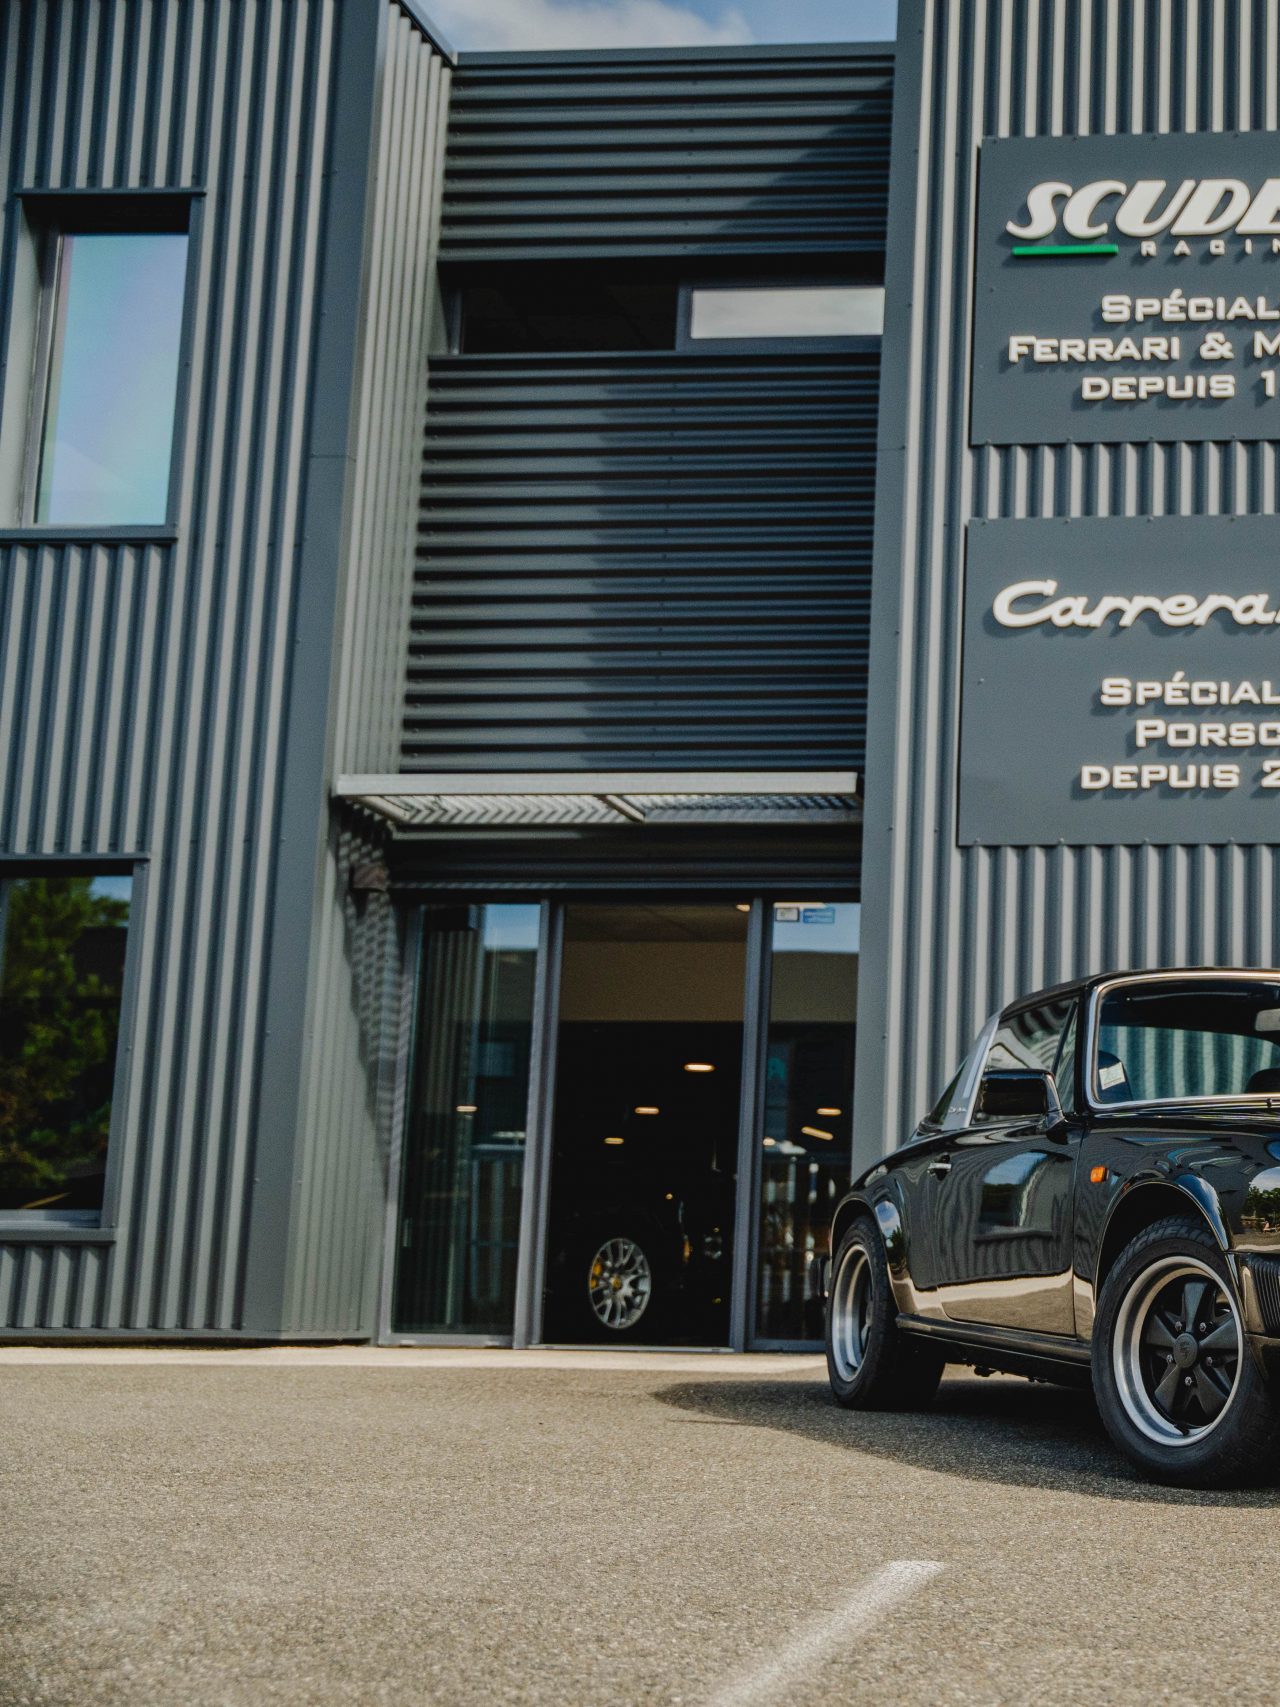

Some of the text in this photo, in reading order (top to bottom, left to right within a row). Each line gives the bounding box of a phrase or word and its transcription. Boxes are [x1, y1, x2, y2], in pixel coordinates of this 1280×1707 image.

[1008, 335, 1180, 363] FERRARI
[1199, 332, 1234, 359] &
[1082, 374, 1236, 400] DEPUIS
[1081, 764, 1240, 790] DEPUIS
